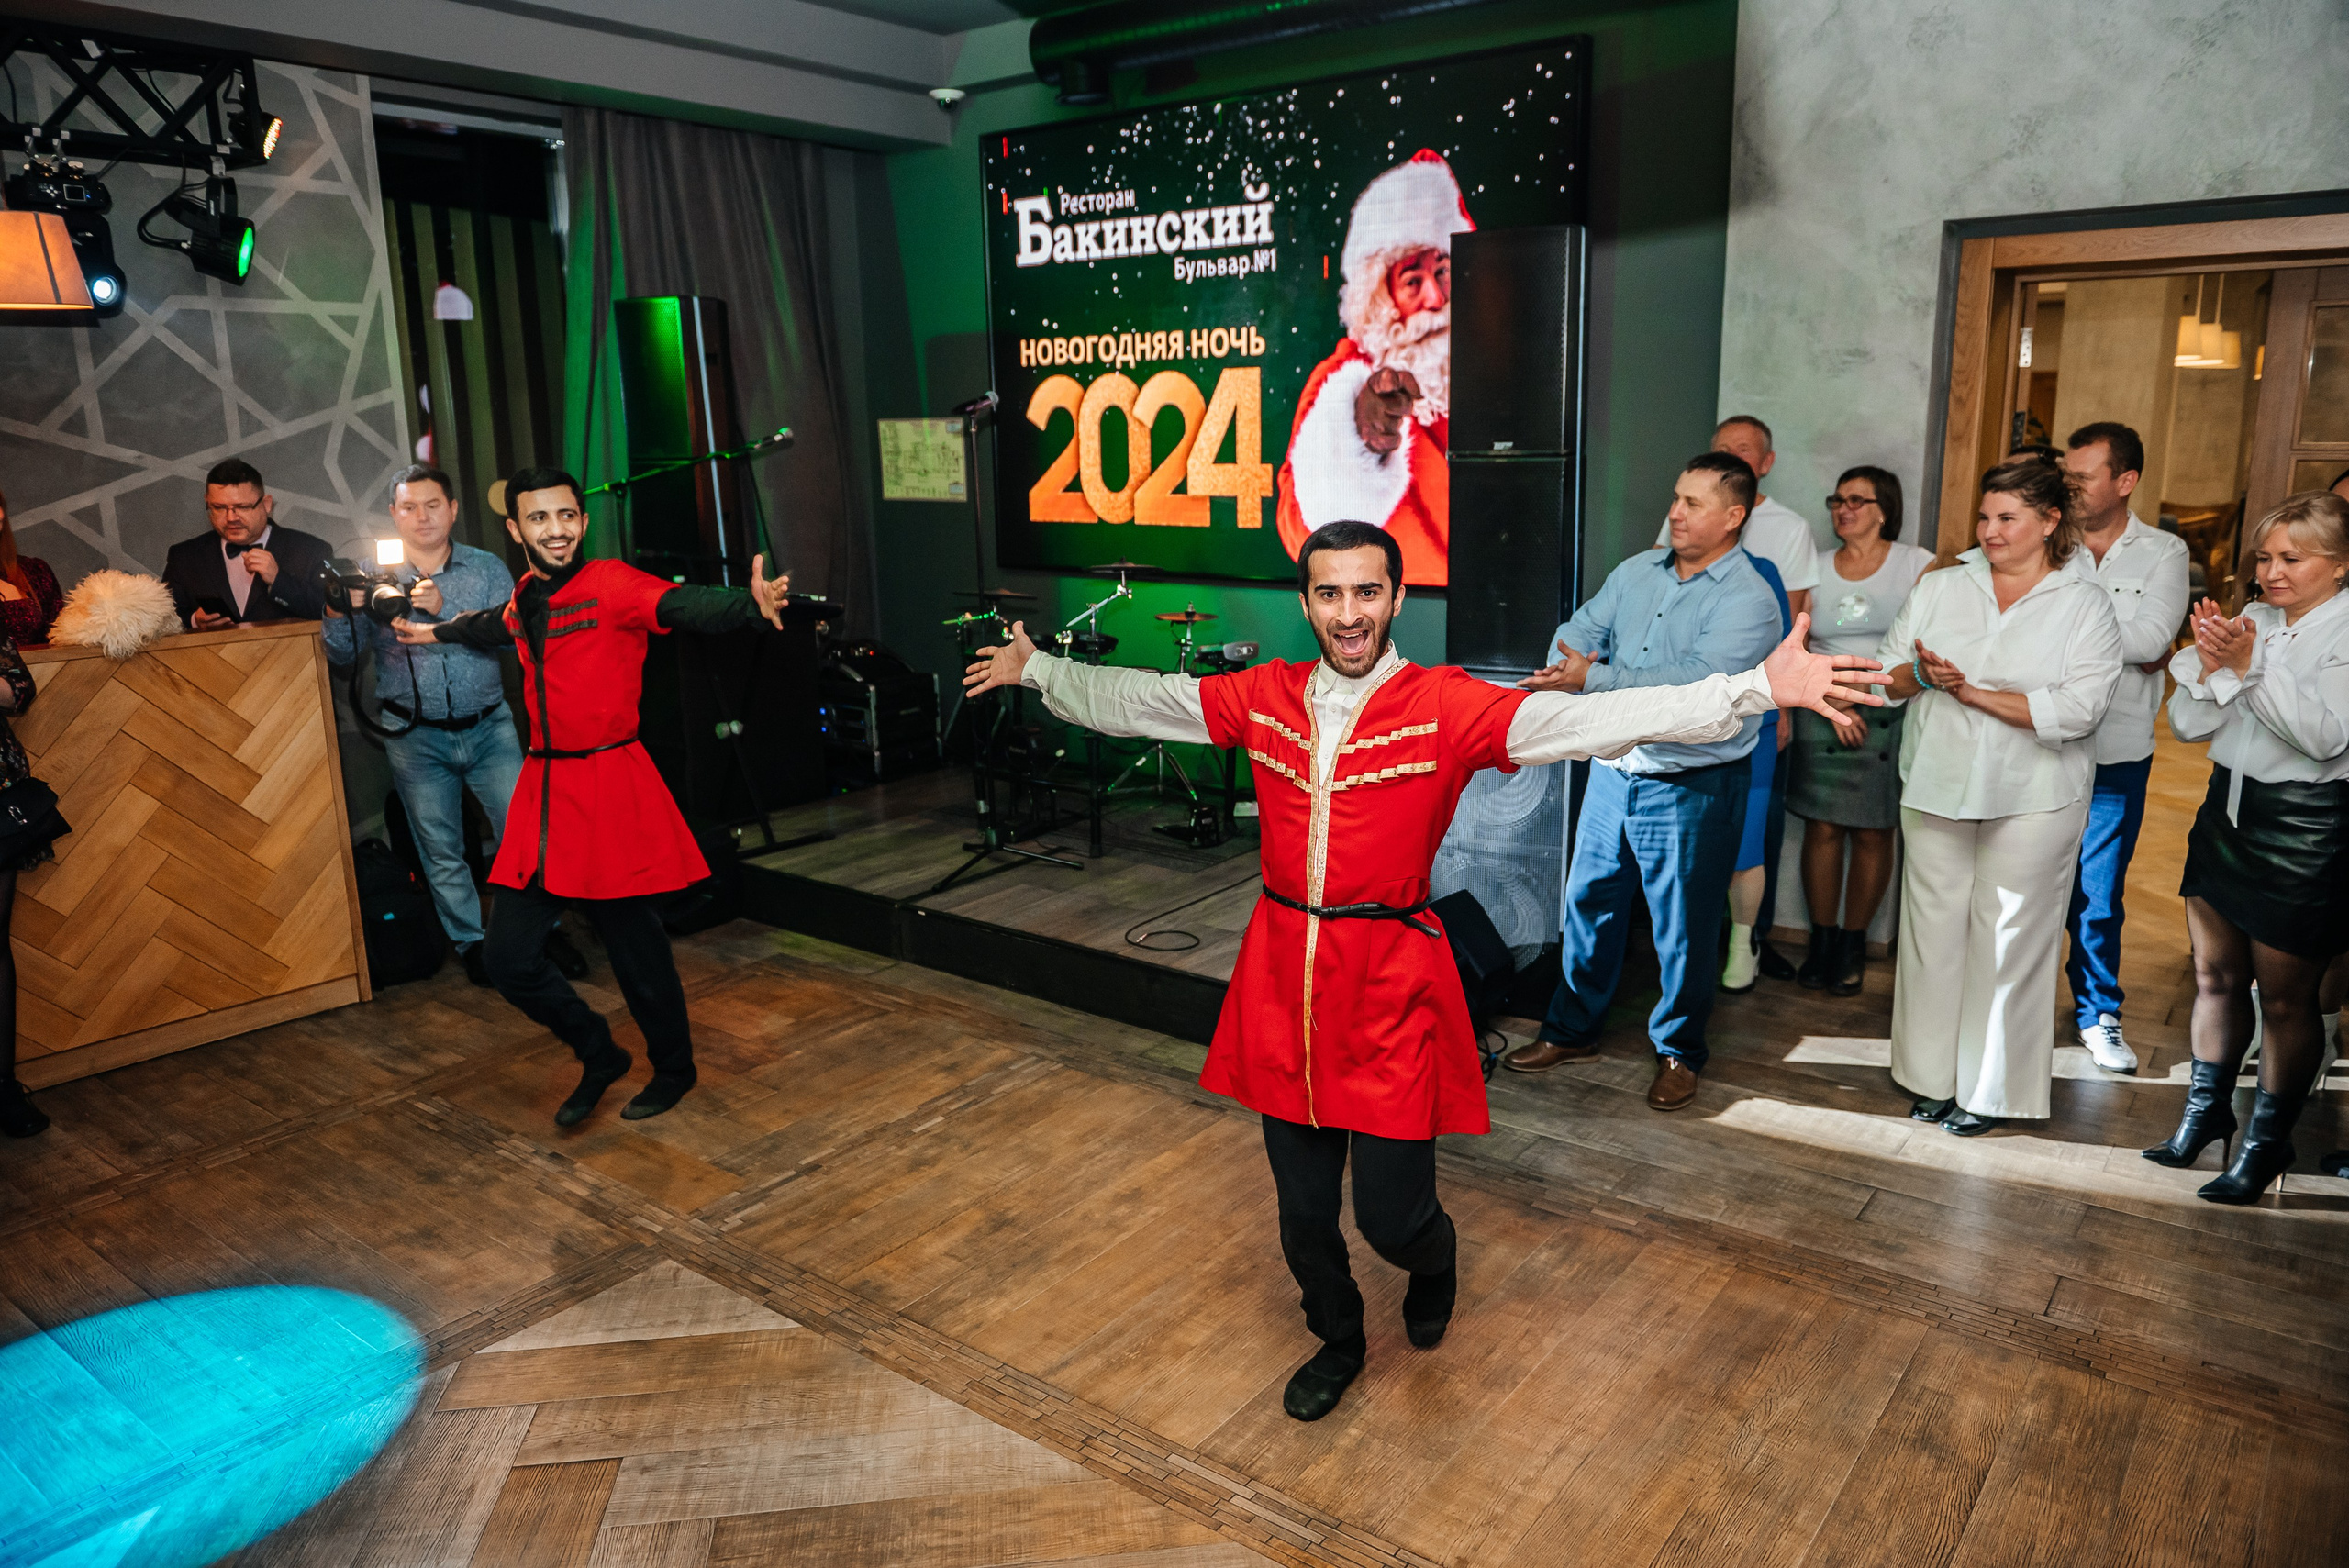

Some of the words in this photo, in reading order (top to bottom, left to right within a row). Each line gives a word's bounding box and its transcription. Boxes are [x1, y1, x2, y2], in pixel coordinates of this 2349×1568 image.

[1060, 189, 1135, 216] Ресторан
[1013, 182, 1275, 267] Бакинский
[1174, 256, 1251, 284] Бульвар
[1253, 248, 1277, 272] №1
[1019, 335, 1185, 368] НОВОГОДНЯЯ
[1190, 326, 1266, 358] НОЧЬ
[1026, 366, 1274, 529] 2024
